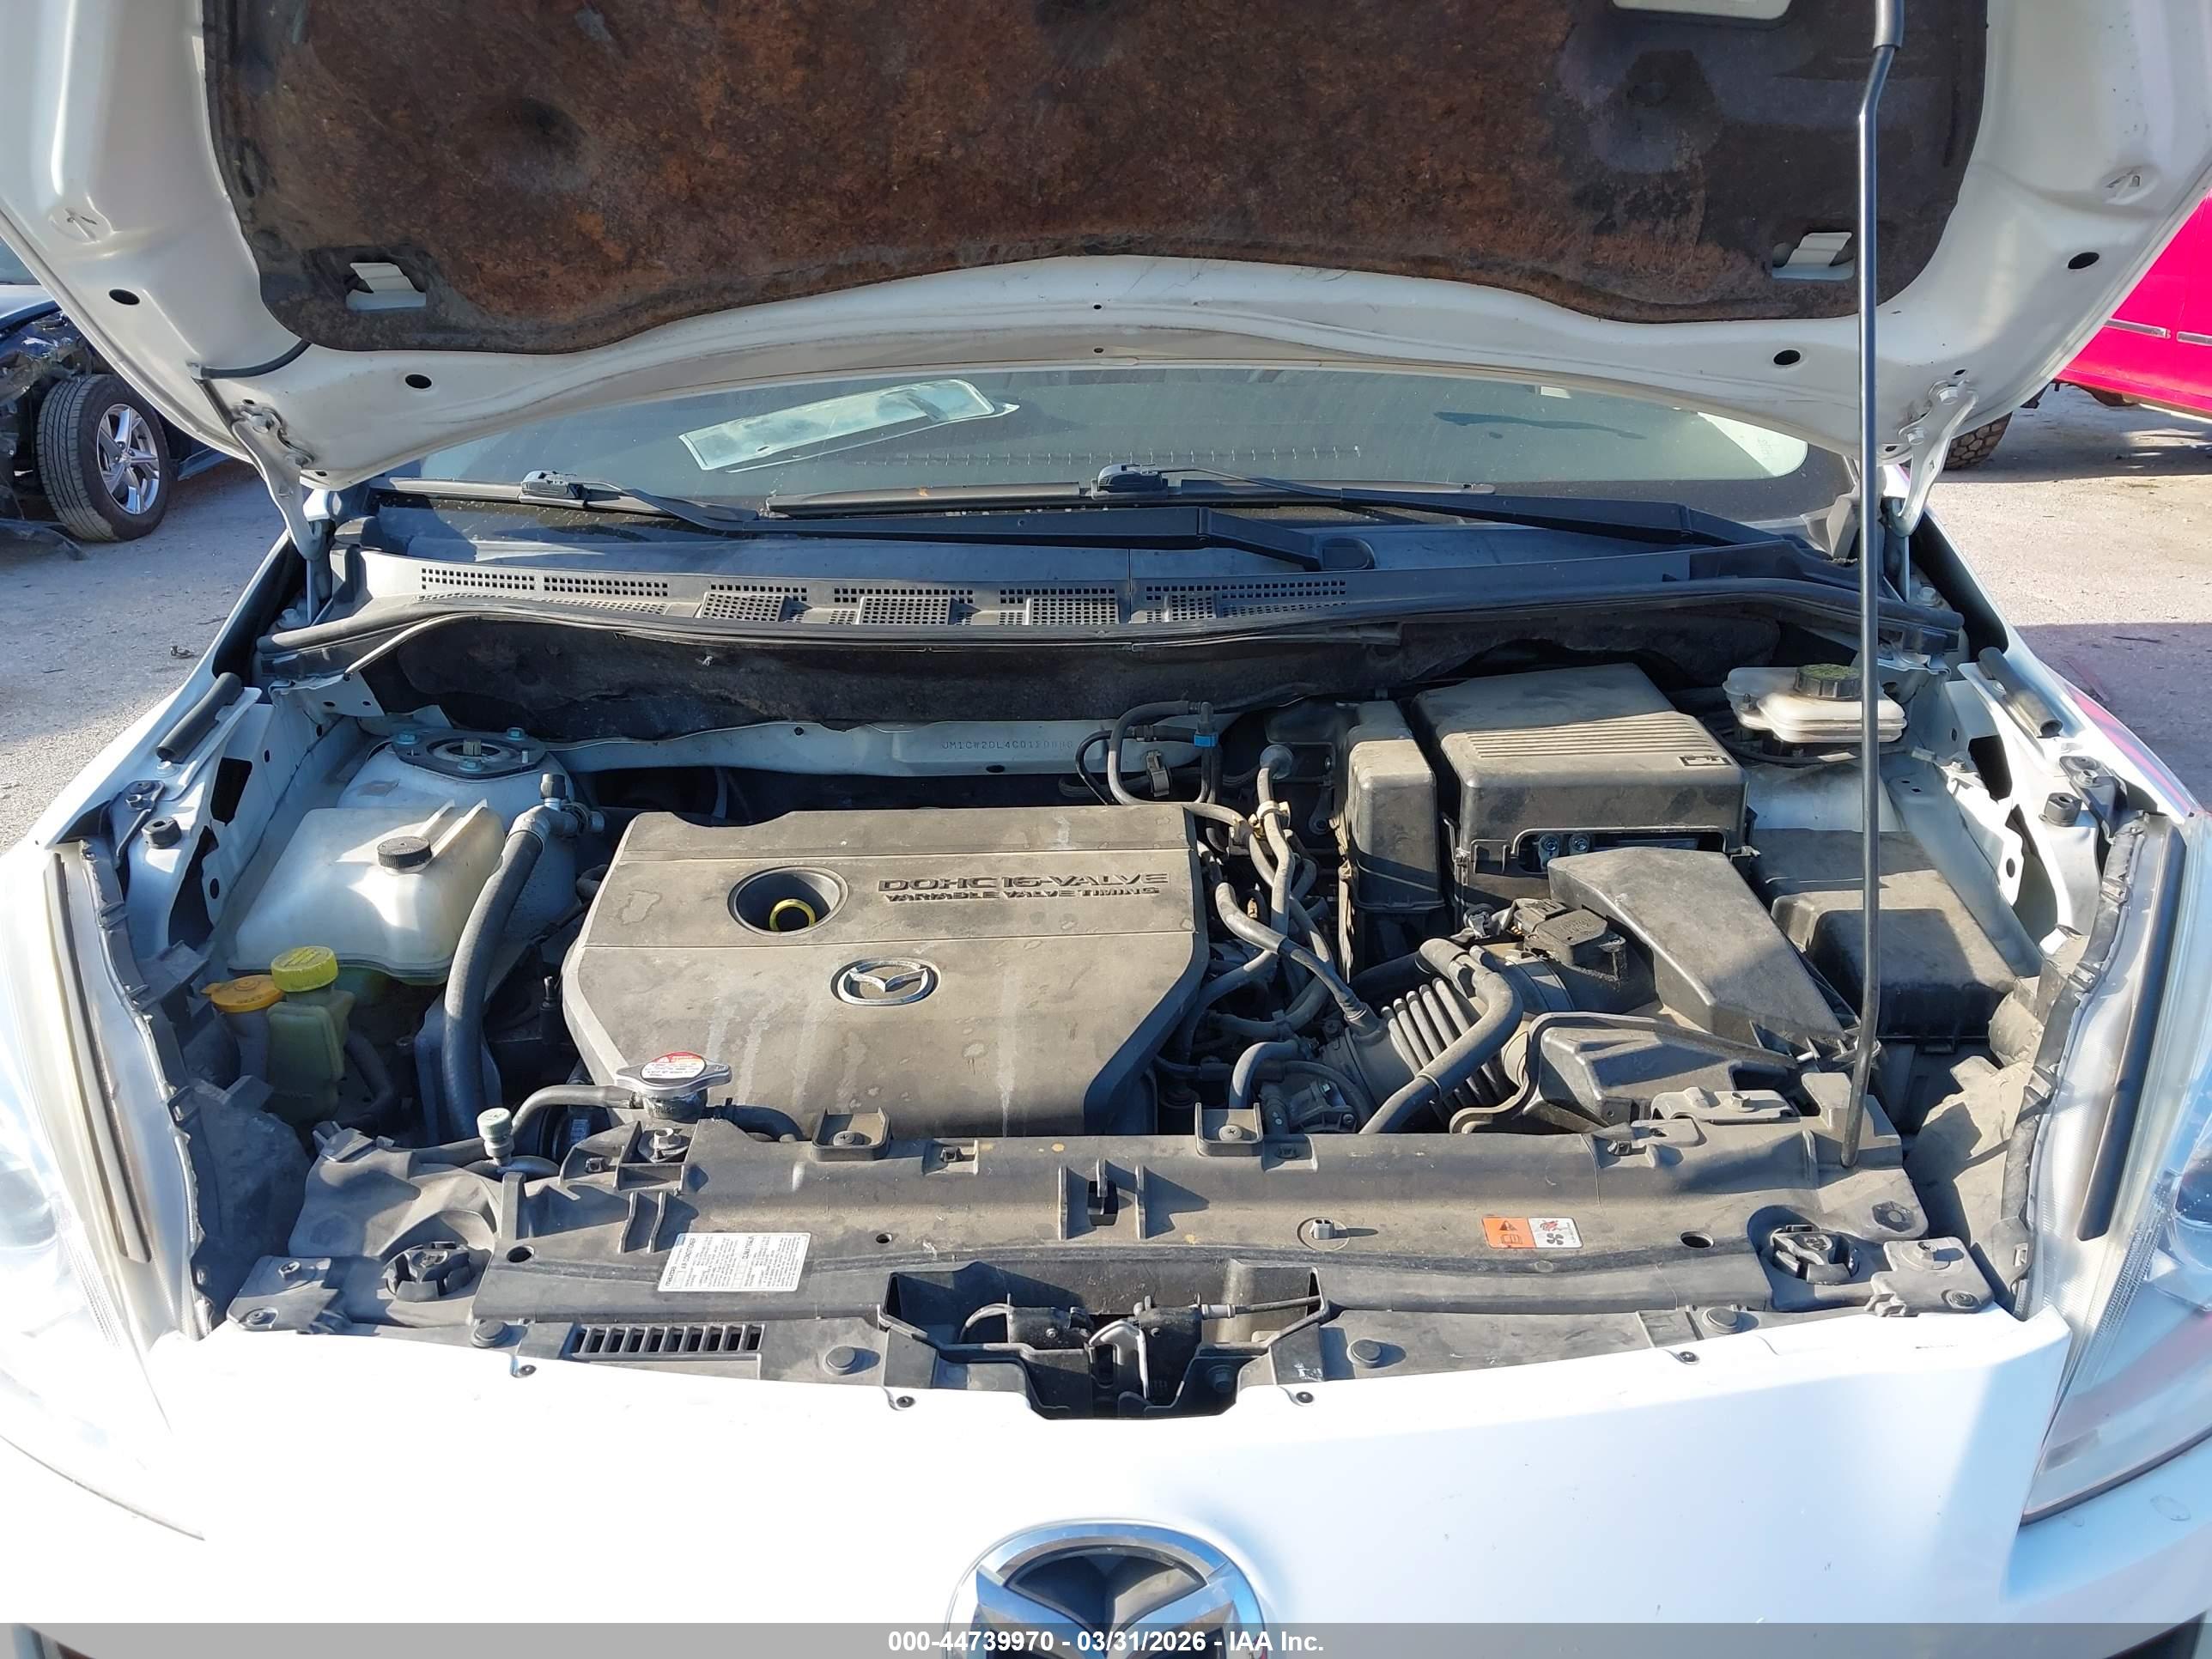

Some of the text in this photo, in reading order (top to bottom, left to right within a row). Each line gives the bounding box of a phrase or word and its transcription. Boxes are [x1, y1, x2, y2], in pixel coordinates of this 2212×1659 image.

[878, 873, 1169, 891] DOHC 16-VALVE
[885, 887, 1159, 902] VARIABLE VALVE TIMING
